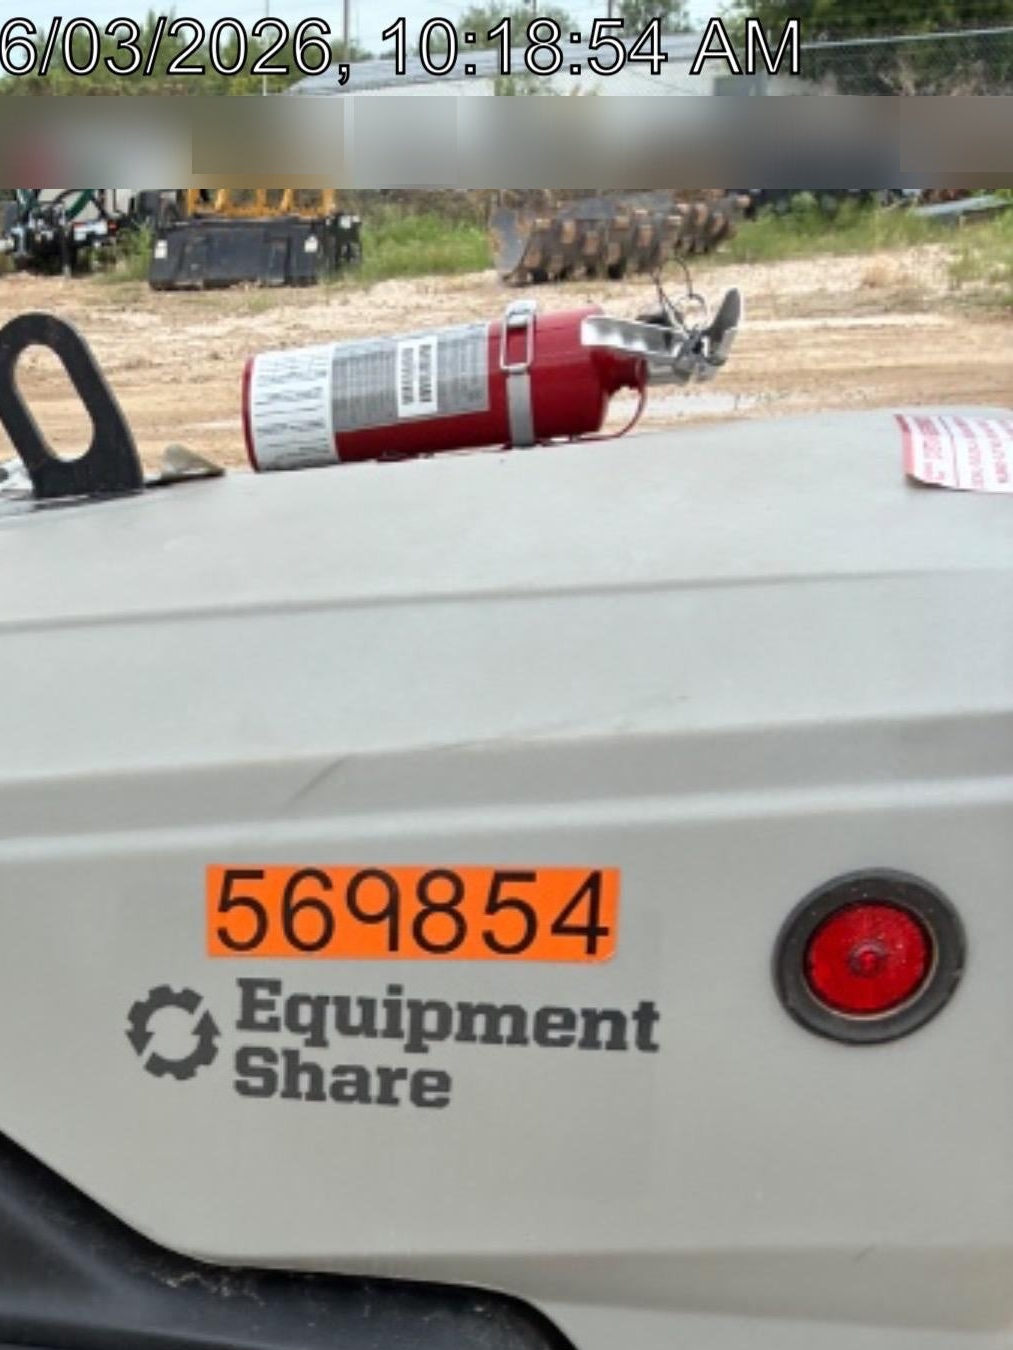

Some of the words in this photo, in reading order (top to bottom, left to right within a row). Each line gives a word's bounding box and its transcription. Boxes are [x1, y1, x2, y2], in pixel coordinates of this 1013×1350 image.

[216, 867, 610, 955] 569854
[235, 977, 661, 1054] Equipment
[233, 1046, 453, 1109] Share
